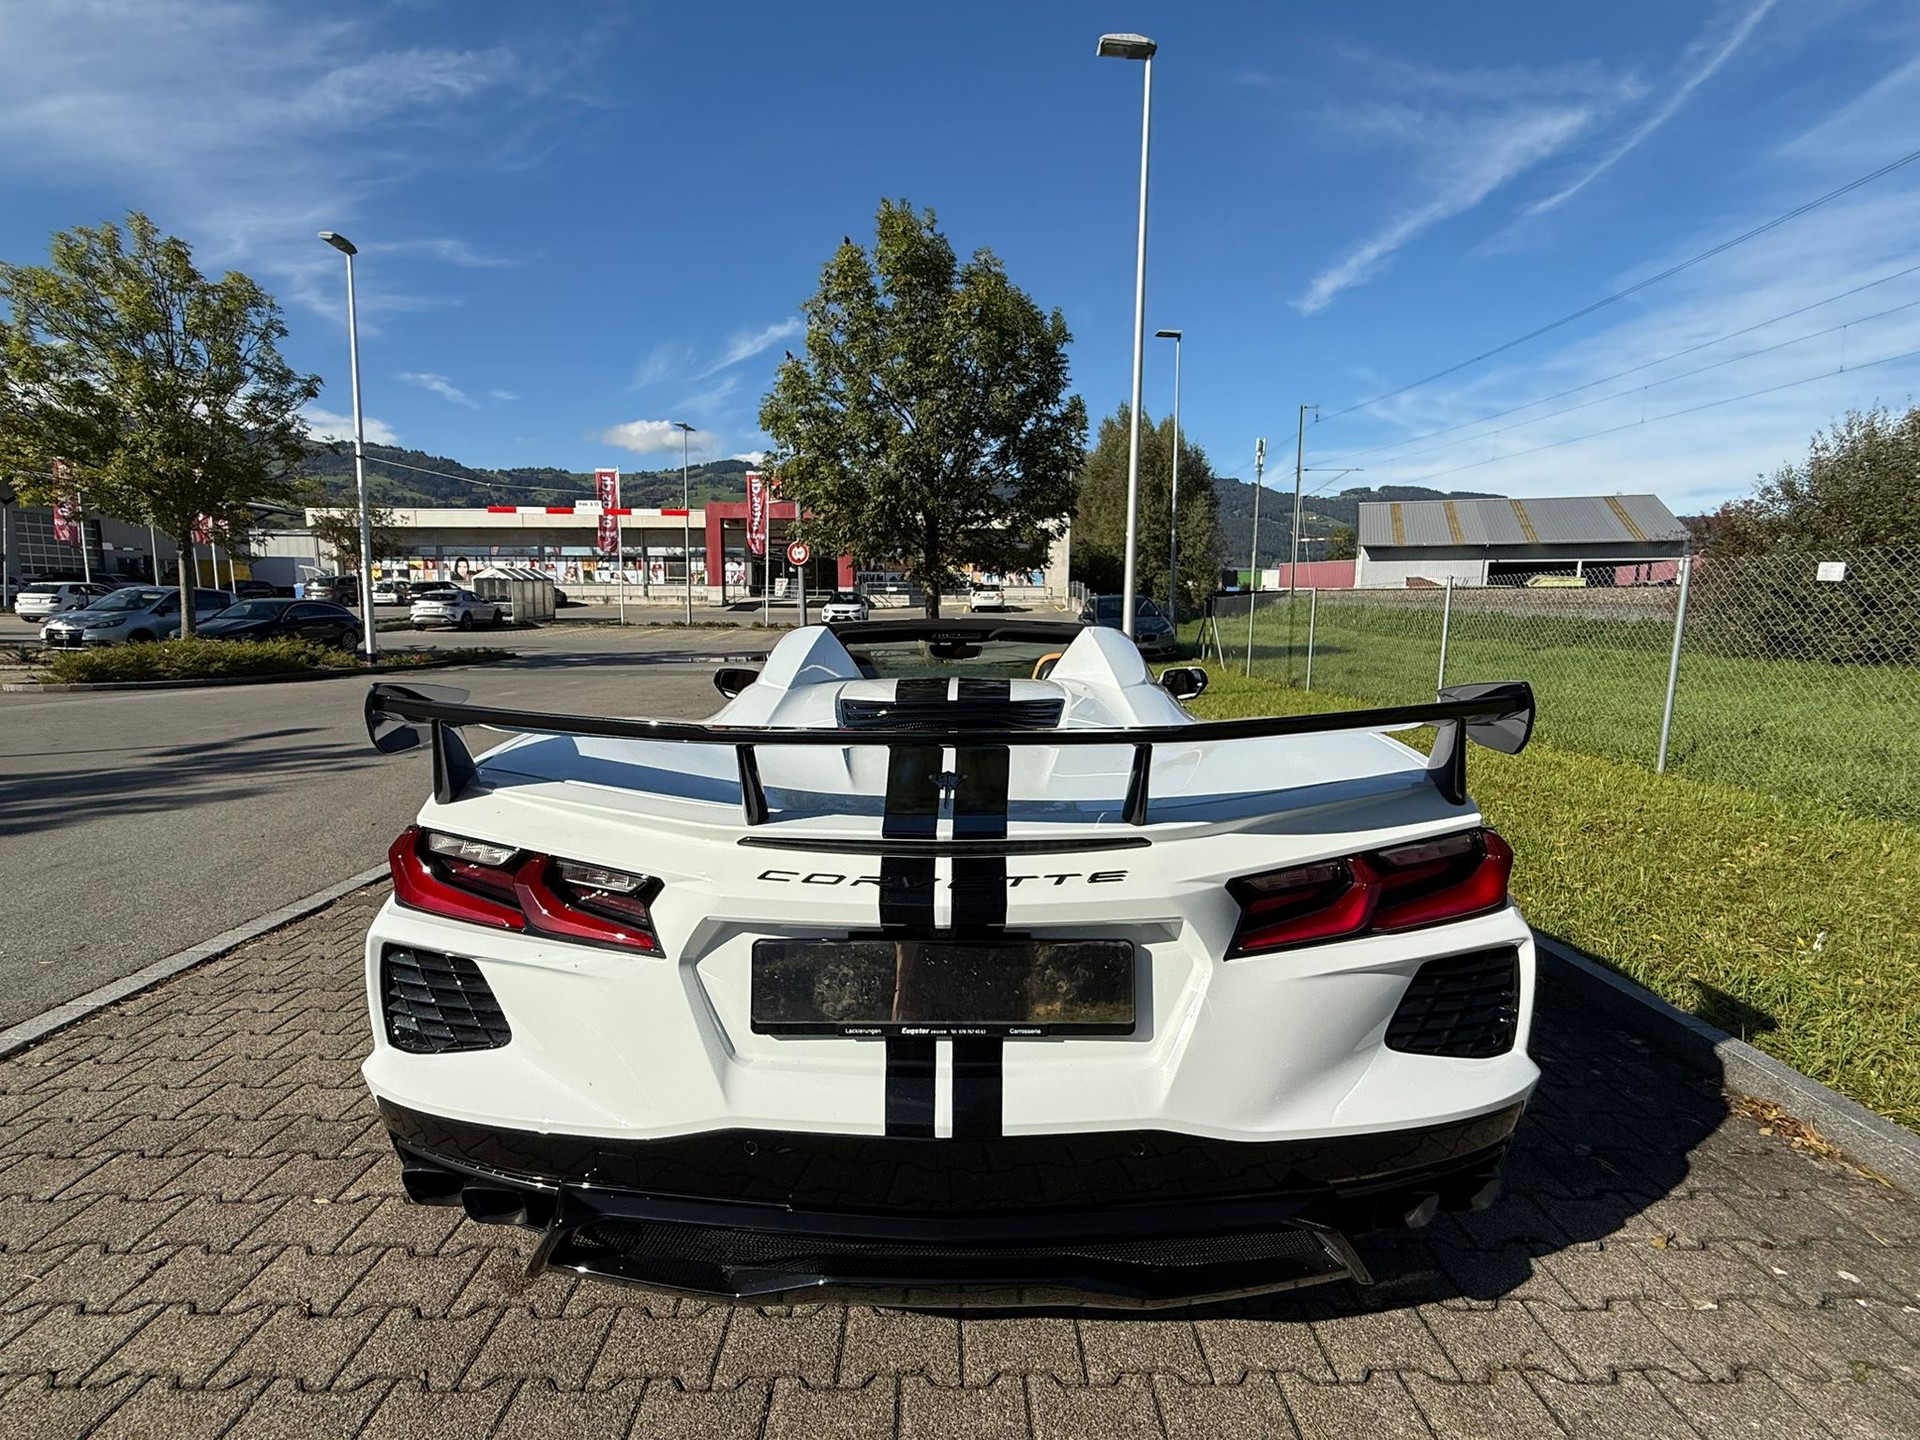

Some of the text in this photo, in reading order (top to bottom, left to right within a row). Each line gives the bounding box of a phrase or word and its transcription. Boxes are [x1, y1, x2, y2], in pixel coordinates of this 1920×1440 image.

[757, 869, 1129, 888] CORVETTE
[845, 1027, 882, 1035] Lackierungen
[901, 1027, 930, 1035] Eugster
[1009, 1027, 1041, 1035] Carrosserie
